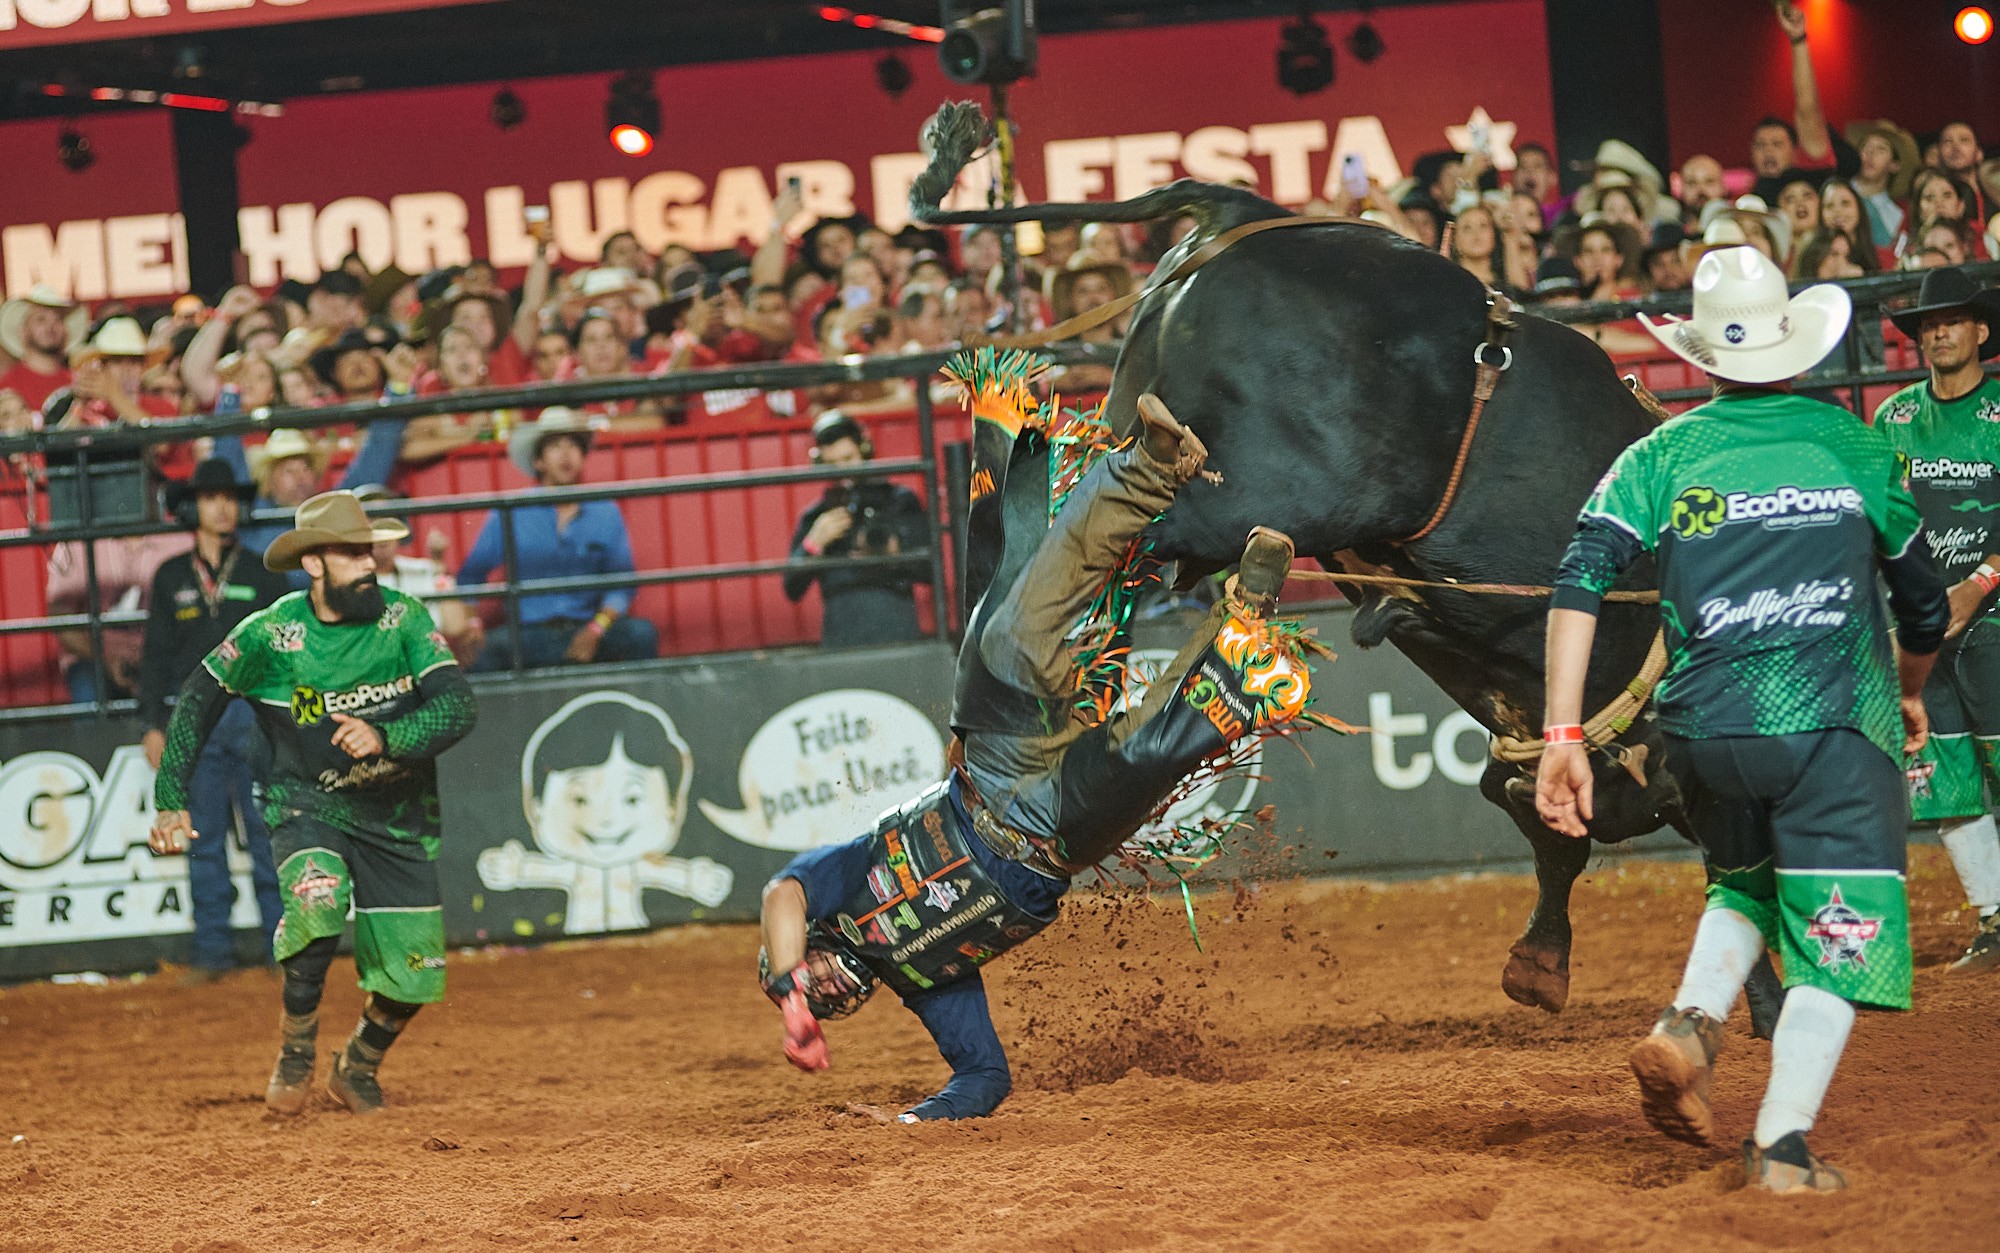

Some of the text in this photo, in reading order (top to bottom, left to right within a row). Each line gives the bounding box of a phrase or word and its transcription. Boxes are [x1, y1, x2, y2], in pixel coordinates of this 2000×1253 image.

[484, 157, 857, 269] LUGAR
[1043, 115, 1404, 206] FESTA
[1911, 457, 1993, 479] EcoPower
[1726, 488, 1862, 521] EcoPowe
[1938, 545, 1984, 570] Team
[323, 675, 413, 713] EcoPower
[795, 712, 870, 758] Feito
[761, 779, 836, 829] para
